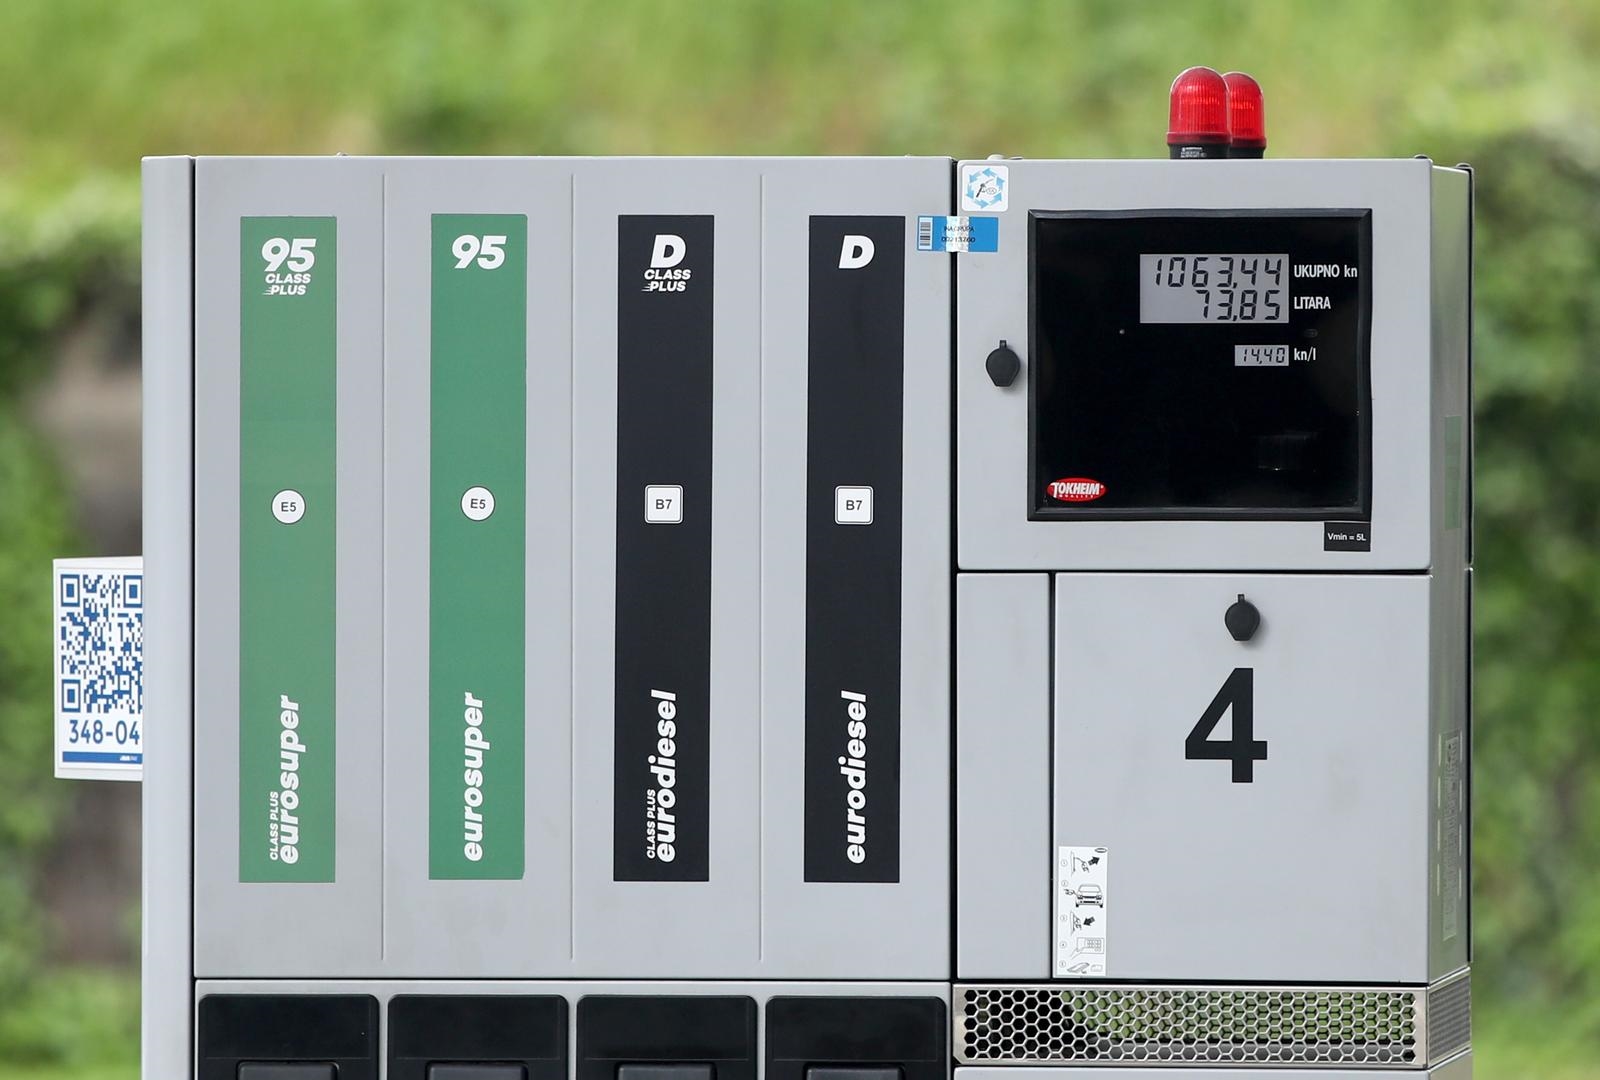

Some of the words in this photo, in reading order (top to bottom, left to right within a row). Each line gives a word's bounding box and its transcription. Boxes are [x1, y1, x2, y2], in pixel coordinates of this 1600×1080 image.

[261, 237, 317, 271] 95
[451, 234, 507, 270] 95
[650, 234, 686, 268] D
[838, 234, 875, 269] D
[265, 273, 312, 284] CLASS
[644, 268, 691, 280] CLASS
[1155, 256, 1283, 289] 1063,44
[1293, 264, 1341, 278] UKUPNO
[1344, 264, 1358, 278] kn
[270, 284, 307, 295] PLUS
[649, 280, 687, 292] PLUS
[1195, 289, 1281, 322] 73,85
[1293, 296, 1331, 310] LITARA
[1240, 346, 1286, 364] 14,40
[1293, 347, 1317, 362] kn/l
[470, 498, 486, 510] E5
[655, 498, 673, 510] B7
[1050, 482, 1100, 498] TOKHEIM
[280, 501, 297, 512] E5
[846, 500, 863, 511] B7
[1327, 532, 1348, 541] Vmin
[1356, 533, 1367, 541] 5L
[69, 719, 141, 746] 348-04
[1184, 667, 1268, 784] 4
[280, 694, 307, 864] eurosuper
[464, 691, 491, 862] eurosuper
[648, 688, 677, 864] eurodiesel
[837, 689, 867, 864] eurodiesel
[269, 791, 279, 821] PLUS
[646, 788, 656, 819] PLUS
[269, 821, 279, 862] CLASS
[646, 819, 656, 860] CLASS
